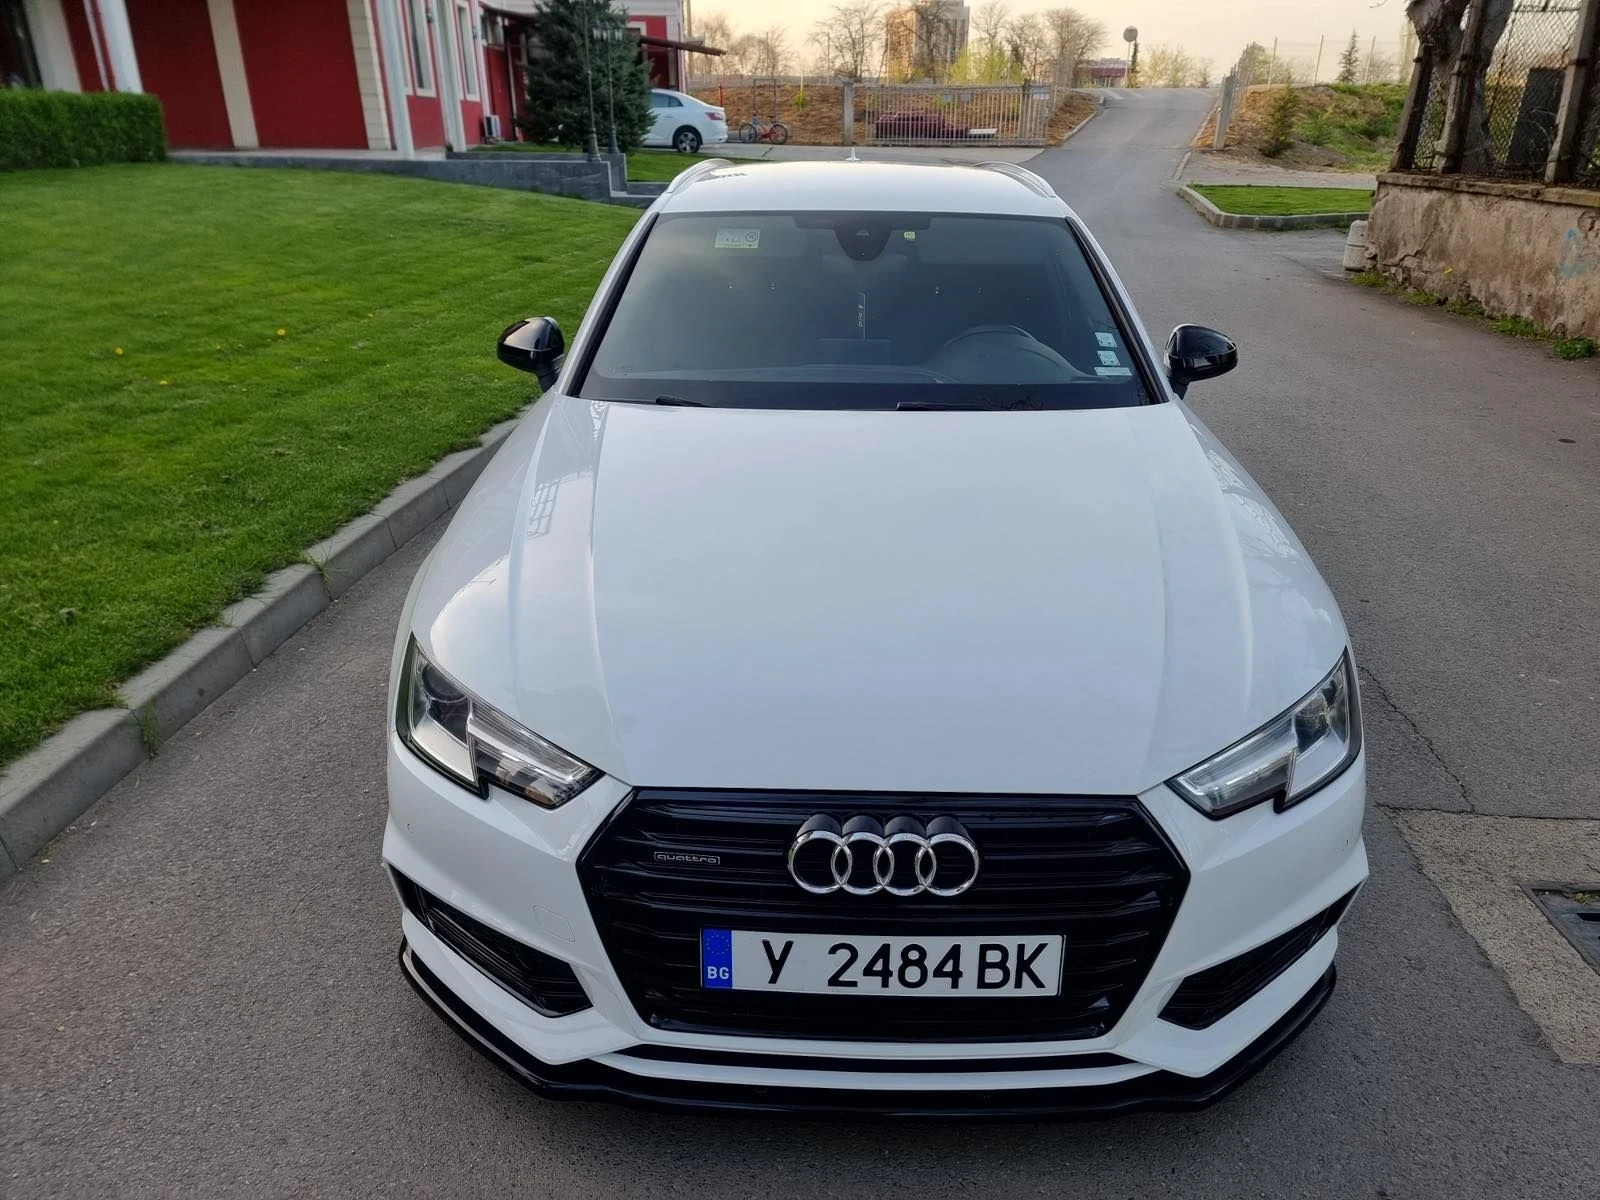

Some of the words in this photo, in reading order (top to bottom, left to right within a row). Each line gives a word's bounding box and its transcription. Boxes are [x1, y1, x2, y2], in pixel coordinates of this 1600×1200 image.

[657, 854, 717, 863] quattro
[762, 939, 794, 984] Y
[707, 966, 730, 979] BG
